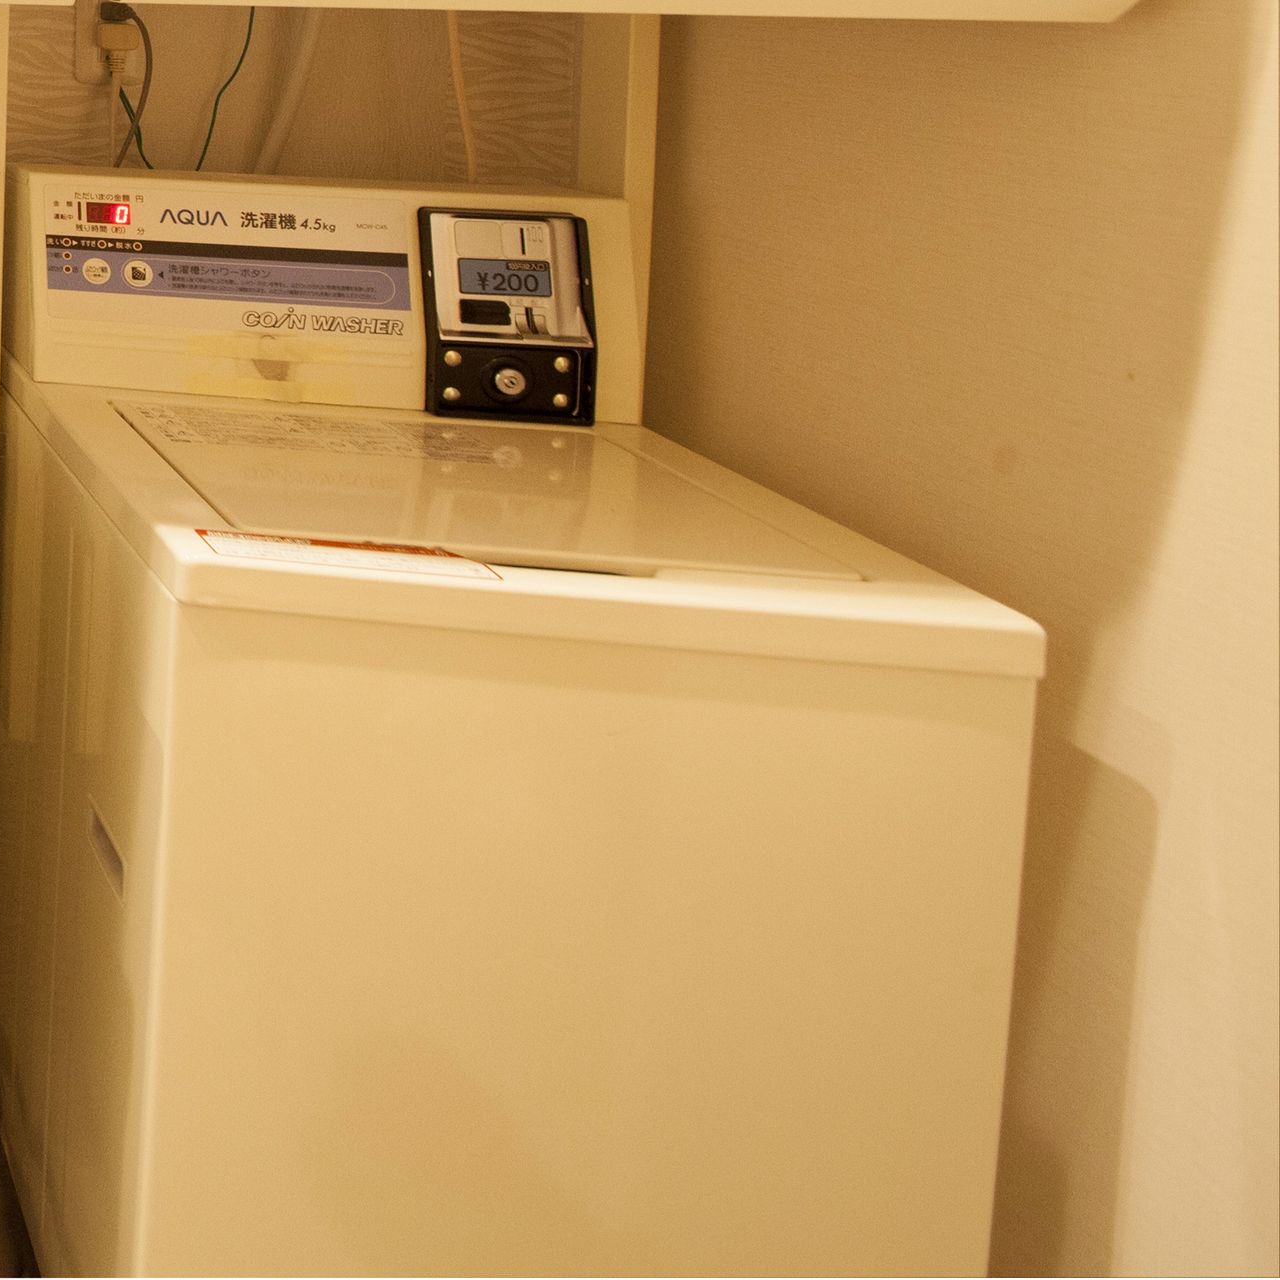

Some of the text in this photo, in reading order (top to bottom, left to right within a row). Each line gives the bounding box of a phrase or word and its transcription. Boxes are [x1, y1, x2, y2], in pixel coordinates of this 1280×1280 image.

[115, 205, 129, 223] 0
[160, 208, 337, 233] AQUA 洗濯機 4.5kg
[477, 271, 539, 293] ¥200
[311, 315, 404, 336] WASHER
